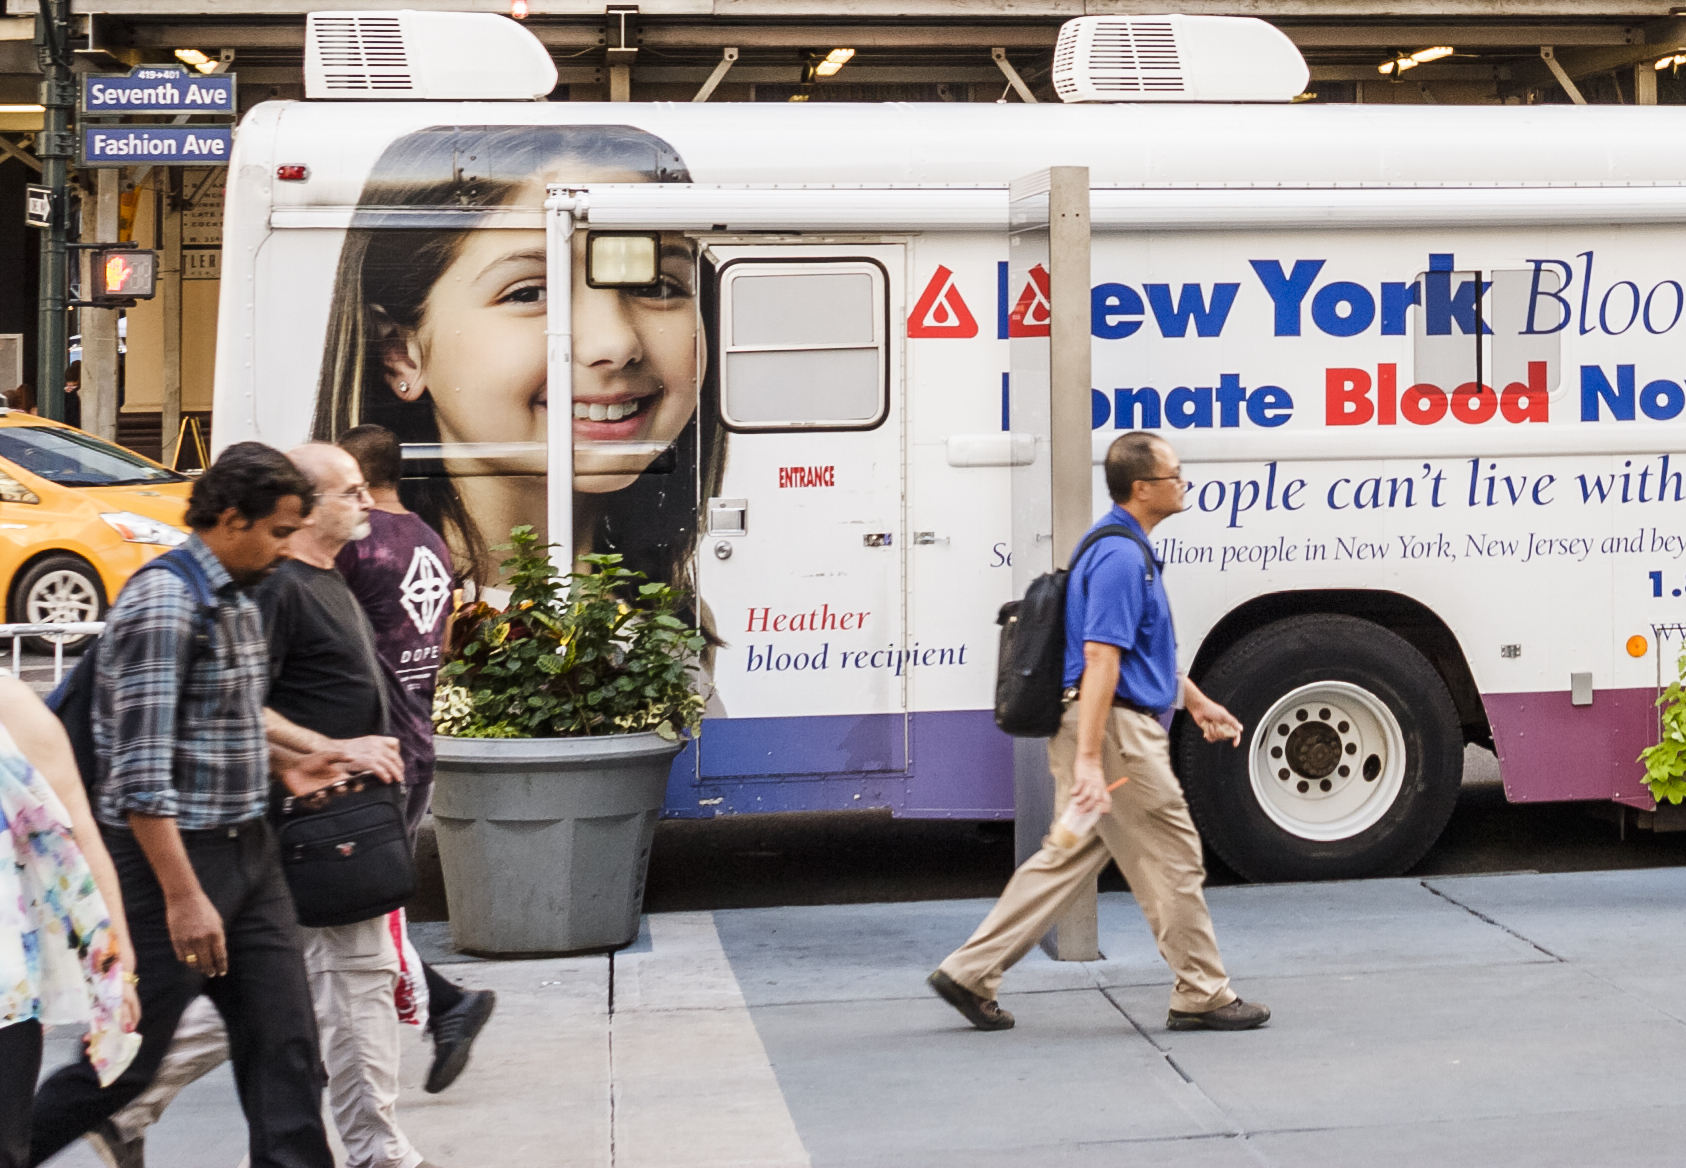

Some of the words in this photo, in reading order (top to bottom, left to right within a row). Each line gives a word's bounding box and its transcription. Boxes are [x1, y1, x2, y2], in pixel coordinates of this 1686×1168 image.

[91, 83, 180, 105] Seventh
[184, 86, 227, 104] Ave
[94, 134, 177, 155] Fashion
[182, 135, 225, 155] Ave
[1248, 252, 1495, 337] York
[1325, 361, 1550, 426] Blood
[778, 465, 835, 489] ENTRANCE
[1326, 462, 1448, 511] can't
[1467, 457, 1558, 508] live
[1153, 537, 1214, 565] illion
[1219, 536, 1297, 571] people
[1304, 538, 1327, 562] in
[1334, 535, 1390, 561] New
[1398, 532, 1458, 563] York,
[1464, 533, 1519, 558] New
[1521, 532, 1595, 563] Jersey
[1600, 528, 1645, 554] and
[745, 603, 872, 633] Heather
[400, 645, 440, 664] DOPE
[746, 642, 830, 673] blood
[840, 642, 969, 677] recipient
